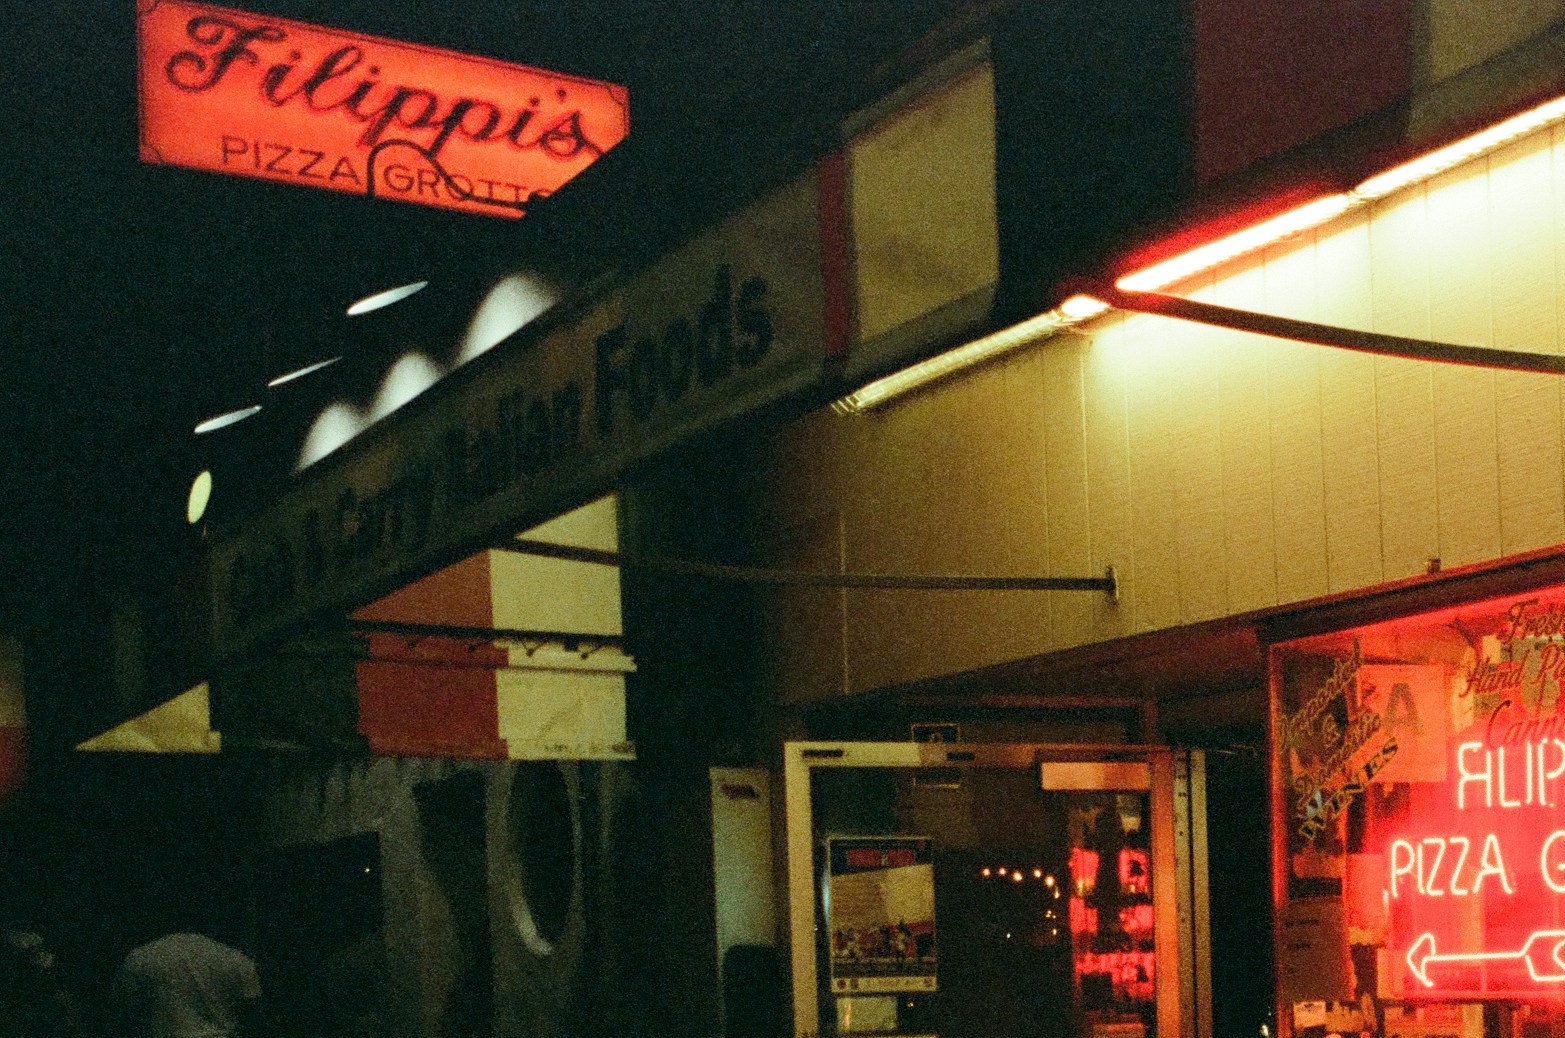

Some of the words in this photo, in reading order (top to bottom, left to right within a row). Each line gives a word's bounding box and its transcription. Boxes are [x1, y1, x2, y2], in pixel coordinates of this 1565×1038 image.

[164, 14, 602, 161] Filippi's
[221, 134, 361, 187] PIZZA
[594, 264, 775, 434] Foods
[1458, 650, 1531, 698] Hand
[1387, 833, 1513, 900] PIZZA
